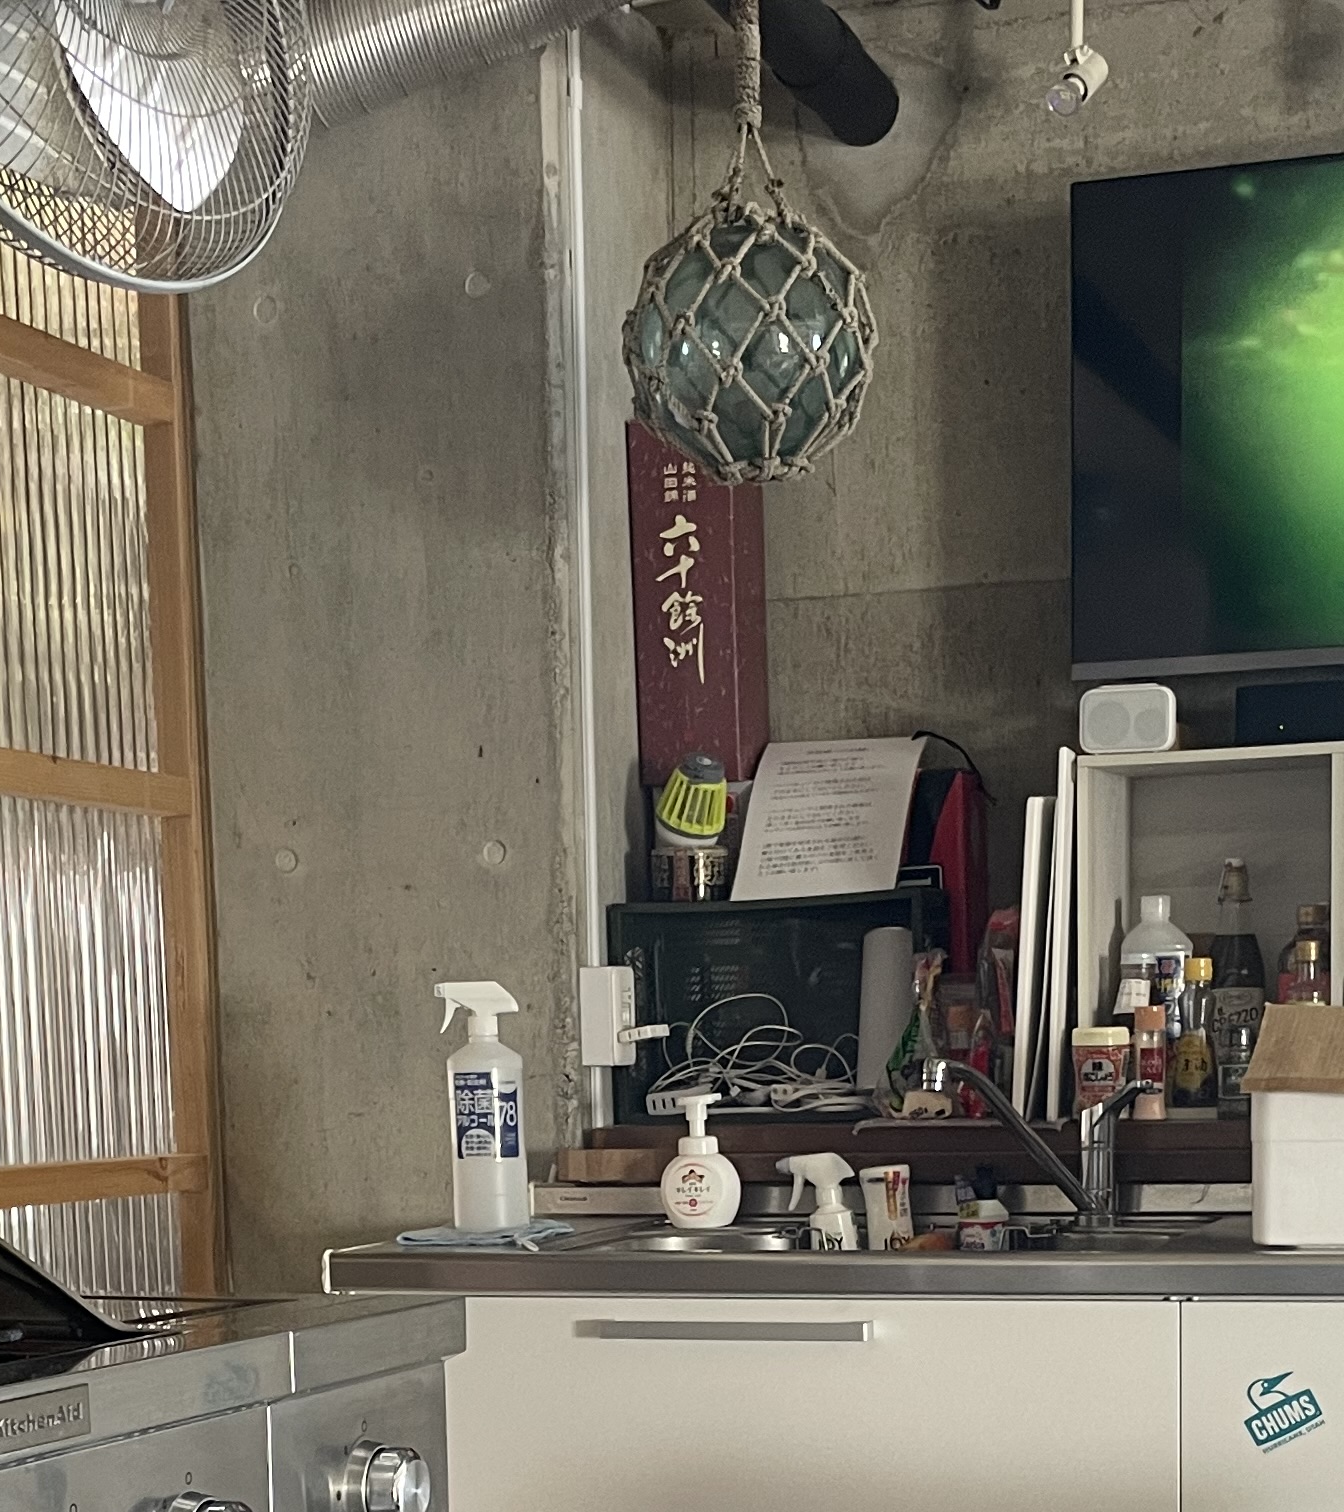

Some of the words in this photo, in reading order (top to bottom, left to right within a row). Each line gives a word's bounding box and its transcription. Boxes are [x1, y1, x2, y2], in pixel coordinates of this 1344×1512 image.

[456, 1088, 494, 1114] 除菌
[457, 1114, 496, 1128] アルコール
[1250, 1395, 1317, 1441] CHUMS
